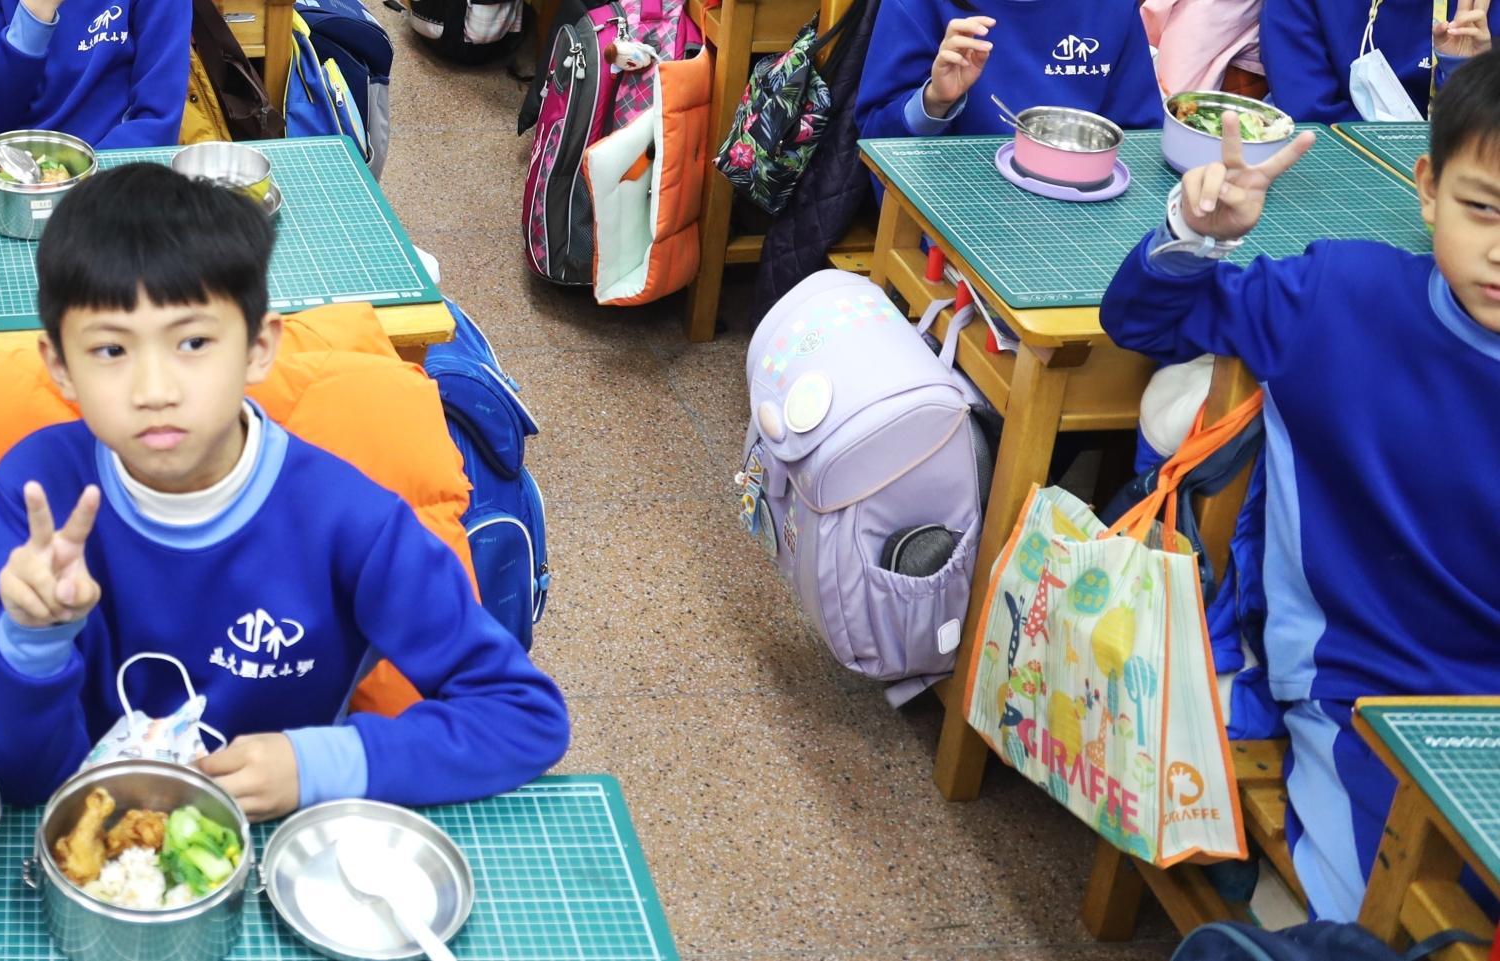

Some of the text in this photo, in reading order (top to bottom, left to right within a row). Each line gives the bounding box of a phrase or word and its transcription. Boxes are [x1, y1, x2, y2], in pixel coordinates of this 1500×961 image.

[1044, 63, 1111, 77] 北大國民小學
[208, 646, 316, 680] 北大國民小學
[1015, 719, 1141, 836] GIRAFFE
[1164, 808, 1222, 825] GIRAFFE
